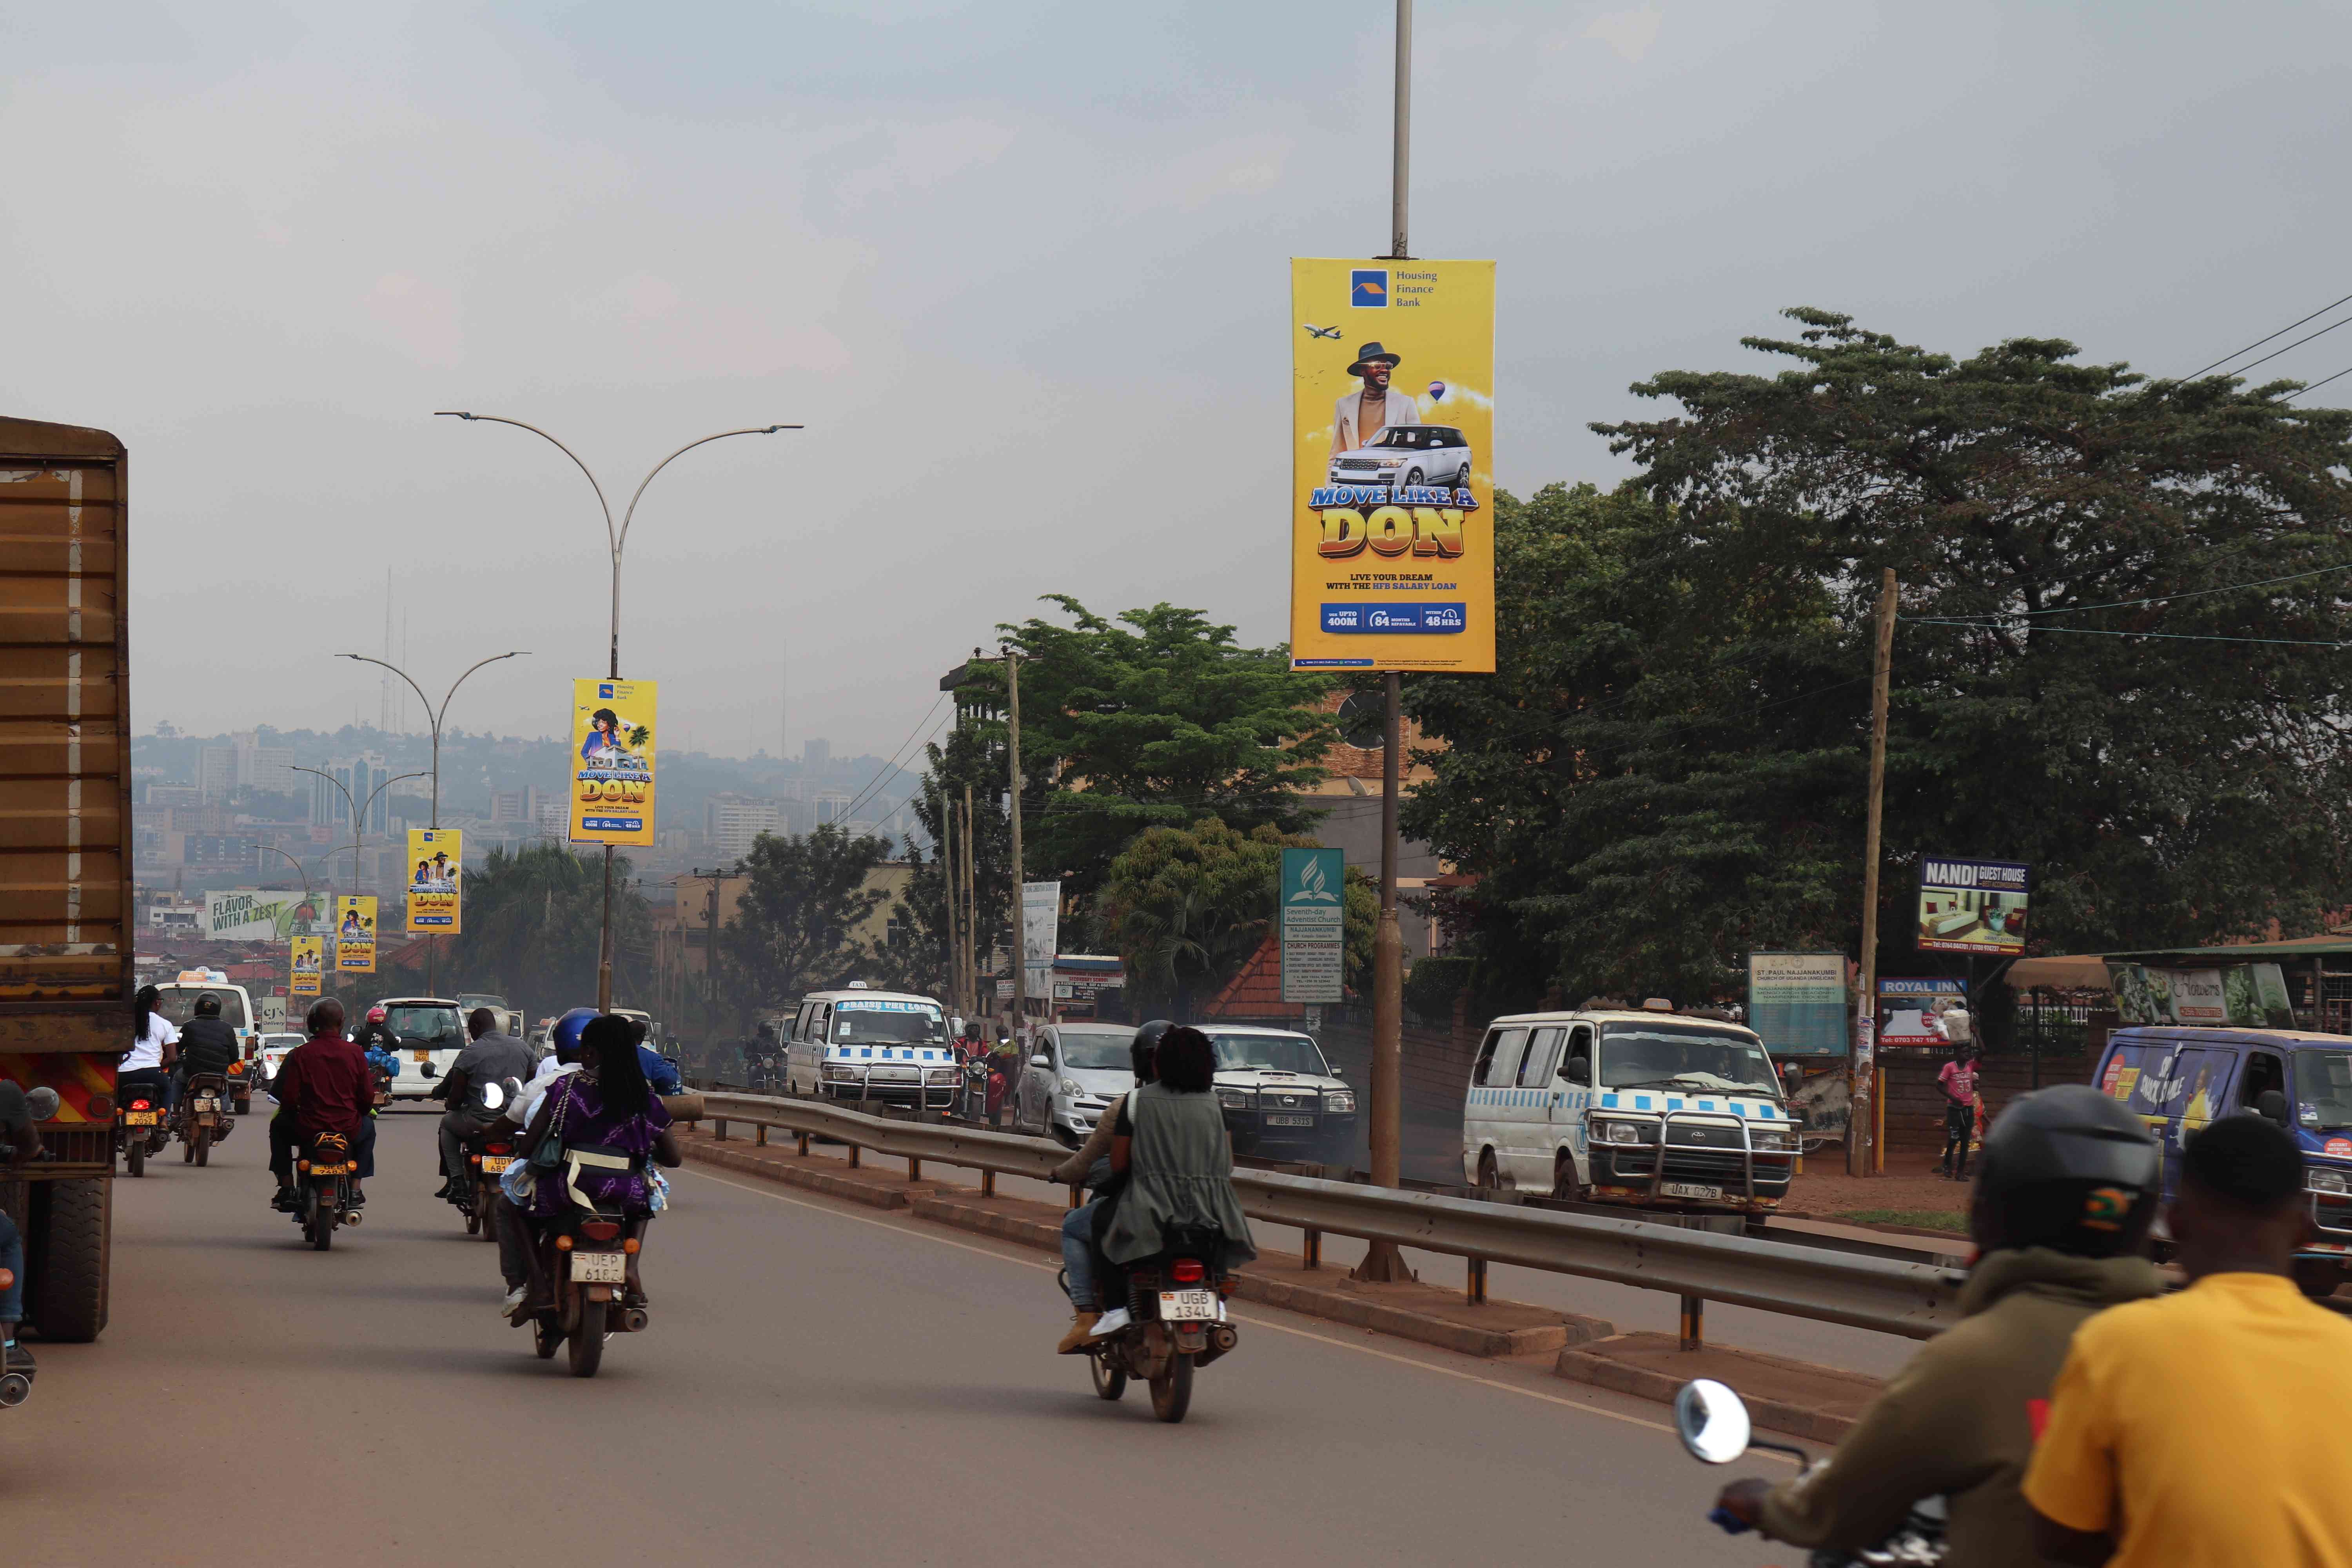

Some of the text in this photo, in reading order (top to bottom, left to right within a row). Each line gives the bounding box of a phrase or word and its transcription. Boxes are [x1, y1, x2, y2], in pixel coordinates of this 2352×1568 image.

[1396, 271, 1437, 282] Housing
[1396, 285, 1434, 293] Finance
[1396, 298, 1421, 307] Bank
[1309, 486, 1479, 510] MOVE LIKE A
[1318, 506, 1465, 557] DON
[1328, 617, 1357, 626] 400M
[1375, 616, 1390, 626] 84
[1426, 616, 1440, 626] 48
[577, 770, 652, 782] MOVE LIKE A
[580, 779, 646, 803] DON
[1926, 862, 2026, 886] NANDI GUEST HOUSE
[213, 895, 252, 916] FLAVOR
[415, 893, 454, 906] DON
[213, 903, 278, 931] WITH A ZEST
[341, 942, 372, 953] DON
[1885, 982, 1963, 992] ROYAL INN
[2172, 971, 2221, 997] Flowers
[884, 1002, 905, 1010] THE
[1672, 1184, 1689, 1196] UAX
[592, 1254, 618, 1266] UEP
[1181, 1293, 1209, 1304] UGB
[1175, 1306, 1211, 1318] 134L
